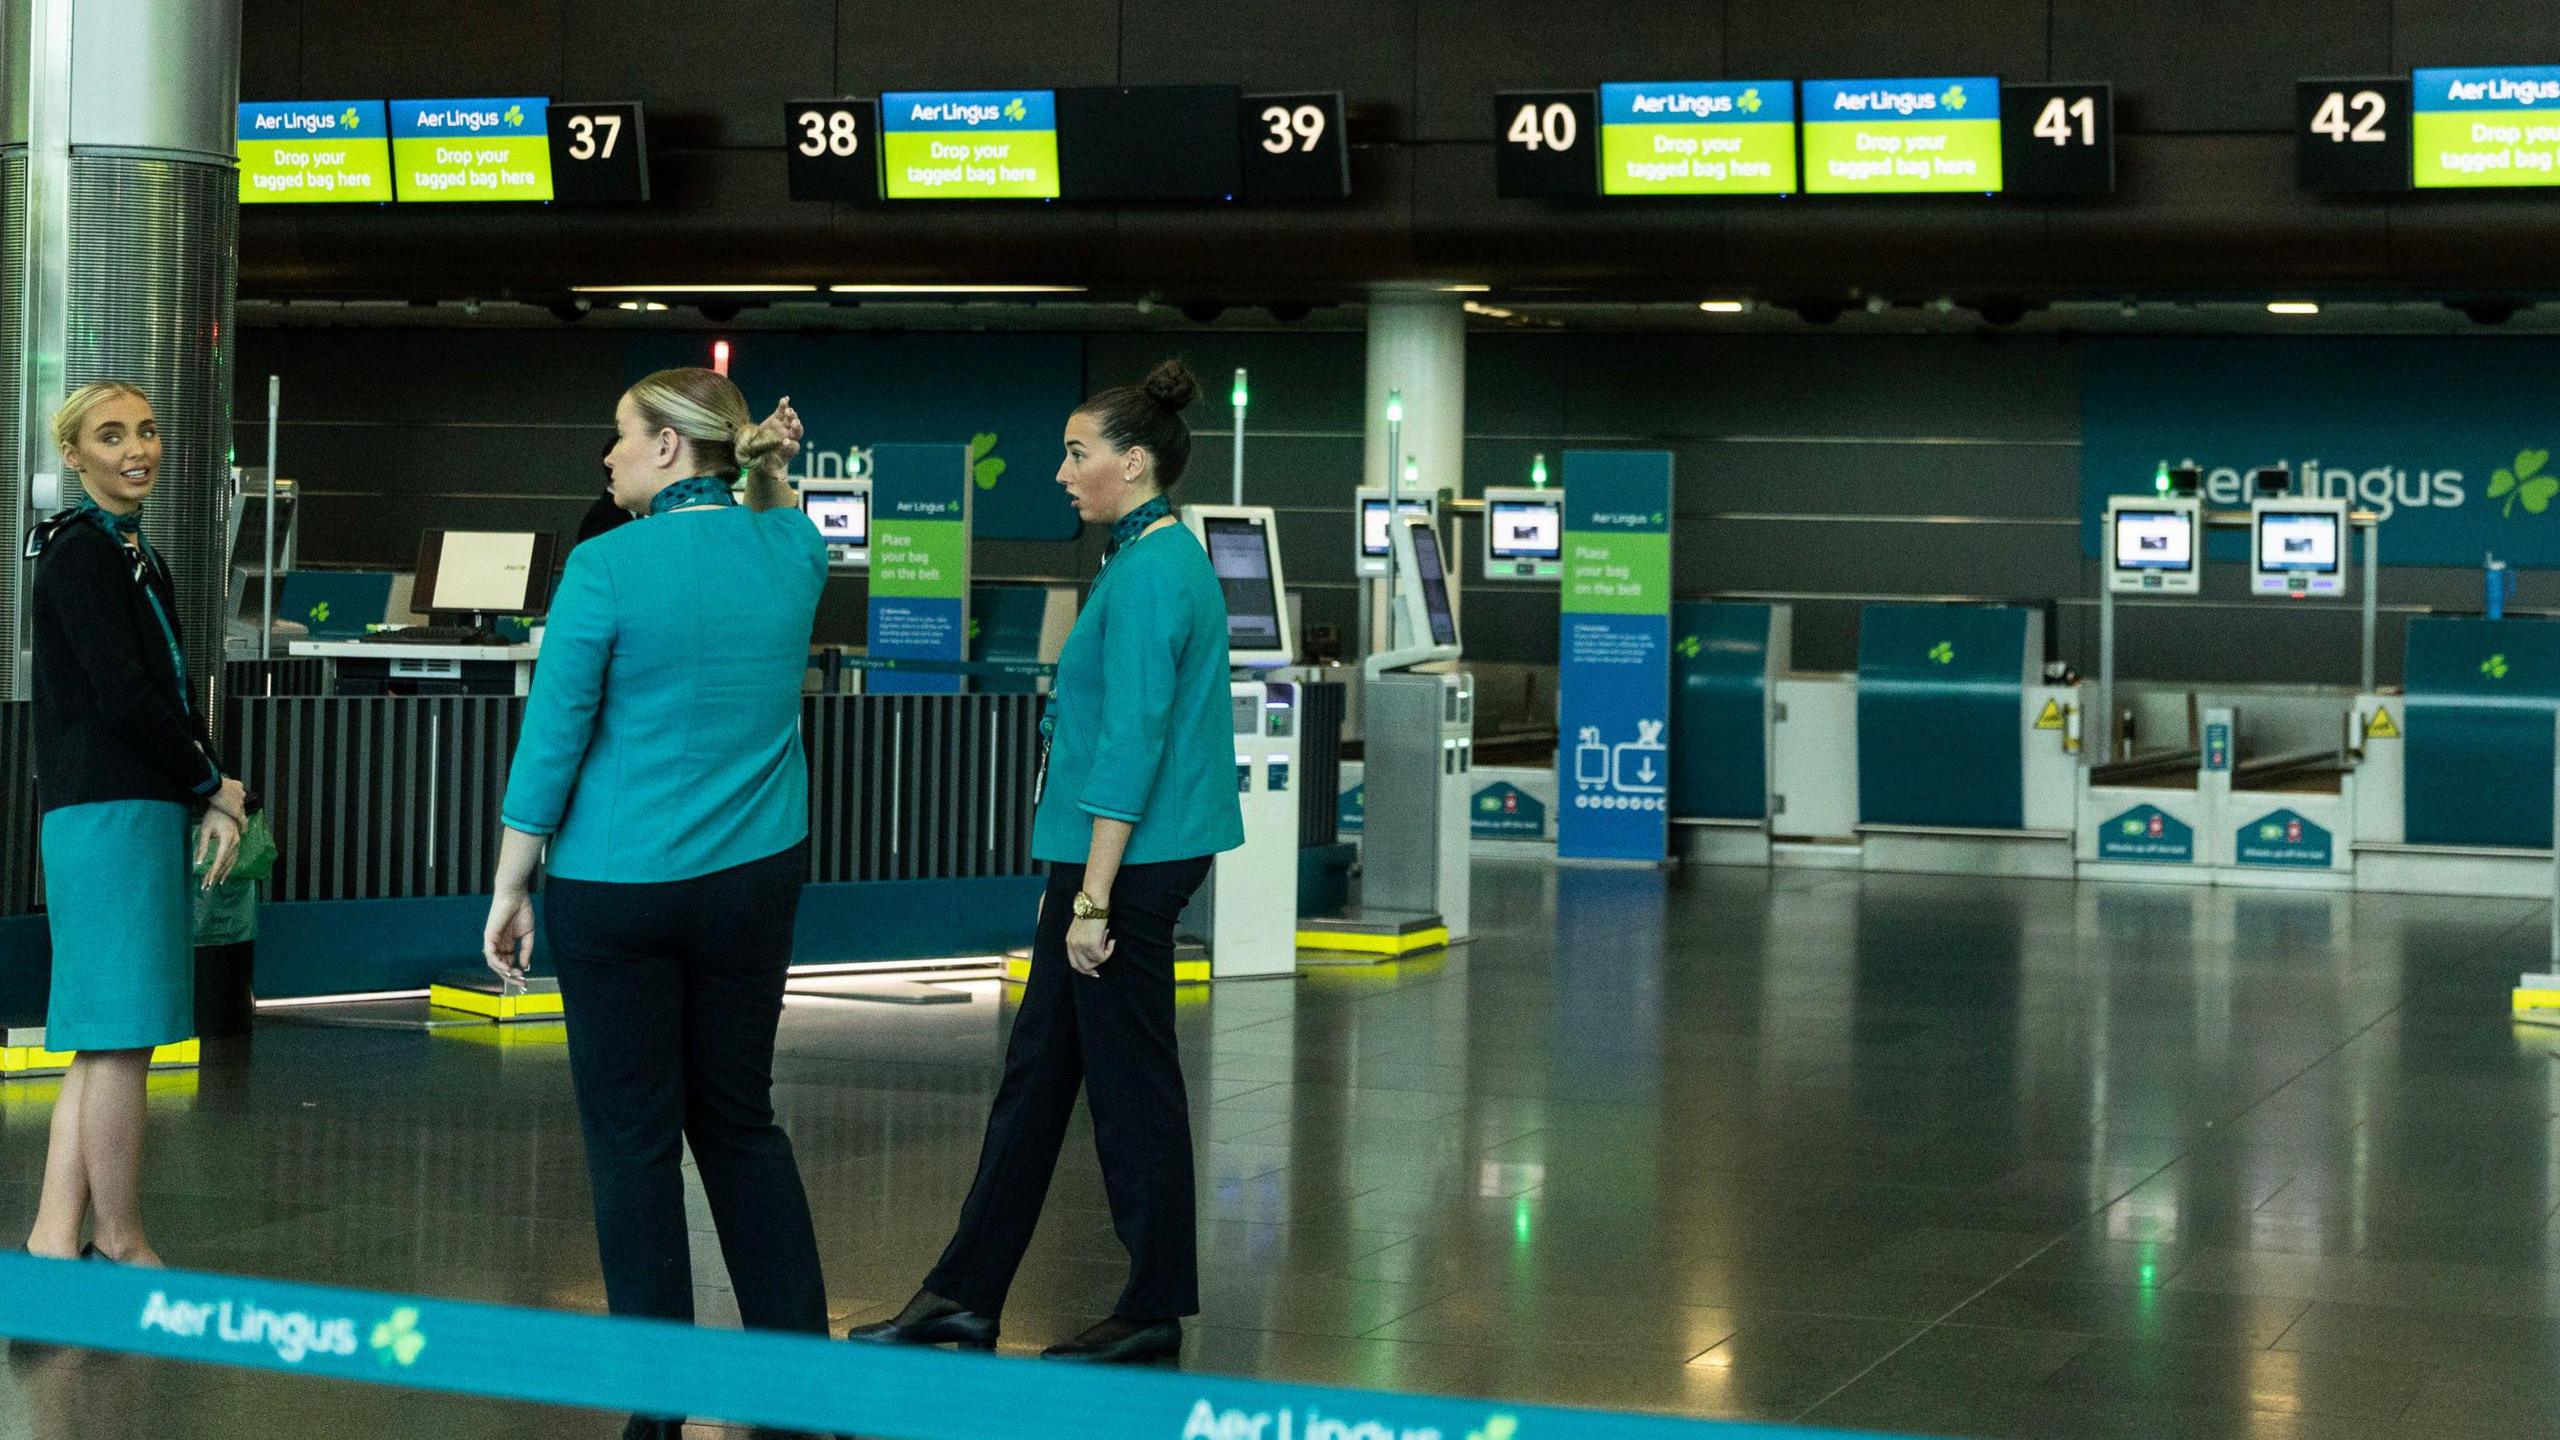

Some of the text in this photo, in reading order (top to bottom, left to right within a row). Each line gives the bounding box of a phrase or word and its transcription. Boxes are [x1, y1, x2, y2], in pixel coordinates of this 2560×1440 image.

[1834, 90, 1936, 115] Aer Lingus
[2448, 79, 2560, 105] Aer Lingus
[911, 102, 999, 125] Aer Lingus
[1632, 93, 1732, 117] Aer Lingus
[2311, 90, 2386, 142] 42
[255, 112, 335, 133] Aer Lingus
[417, 109, 499, 131] Aer Lingus
[1261, 105, 1325, 154] 39
[1508, 103, 1576, 151] 40
[2034, 97, 2094, 146] 41
[568, 115, 621, 160] 37
[799, 111, 858, 157] 38
[1856, 132, 1947, 154] Drop your
[2471, 123, 2560, 146] Drop you
[931, 141, 1010, 162] Drop your
[1653, 135, 1742, 156] Drop your
[274, 149, 346, 168] Drop your
[436, 147, 510, 167] Drop your
[2441, 148, 2510, 173] tagged
[2515, 148, 2551, 172] bag
[415, 168, 535, 190] tagged bag here
[907, 164, 1036, 186] tagged bag here
[1627, 159, 1772, 181] tagged bag here
[1828, 157, 1976, 180] tagged bag here
[253, 171, 371, 191] tagged bag here
[914, 502, 946, 515] Lingus
[881, 533, 911, 546] Place
[881, 551, 929, 566] your bag
[881, 569, 896, 579] on
[897, 566, 916, 580] the
[141, 1290, 358, 1362] Aer Lingus
[1181, 1399, 1271, 1440] Aer
